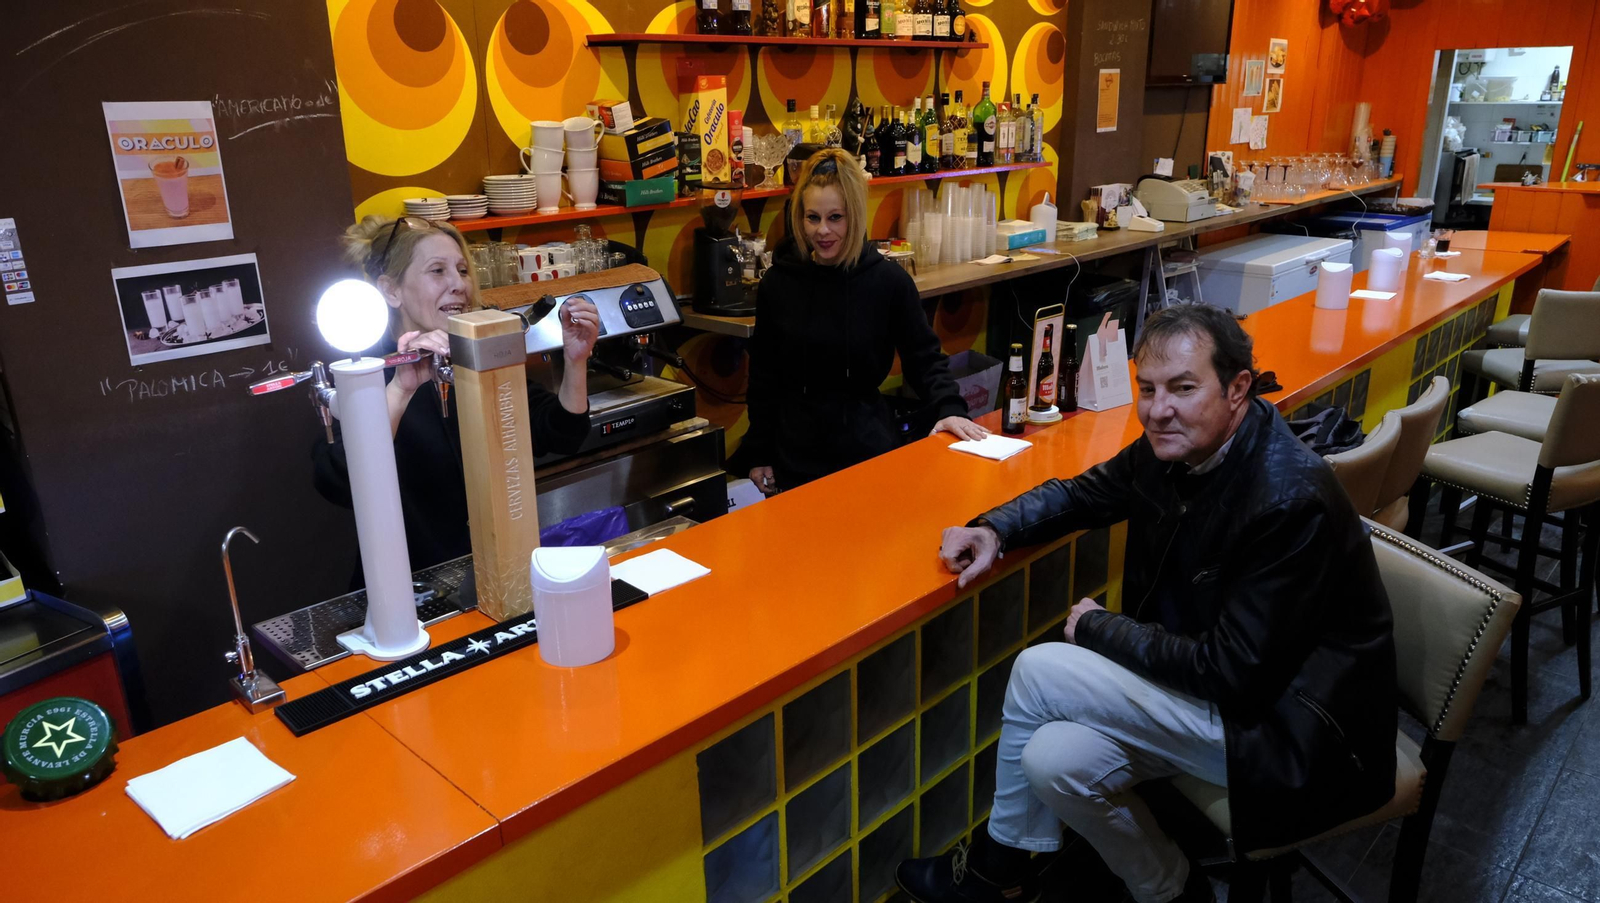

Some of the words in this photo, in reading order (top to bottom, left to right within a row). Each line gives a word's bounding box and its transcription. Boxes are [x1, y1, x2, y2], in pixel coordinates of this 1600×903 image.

[118, 135, 213, 151] ORACULO
[498, 381, 517, 451] ALHAMBRA
[506, 457, 523, 520] CERVEZAS
[350, 651, 466, 699] STELLA
[46, 706, 71, 716] 1963
[74, 708, 98, 750] ESTRELLA
[19, 714, 44, 750] MURCIA
[22, 749, 70, 769] LEVANTE
[72, 750, 88, 763] DE
